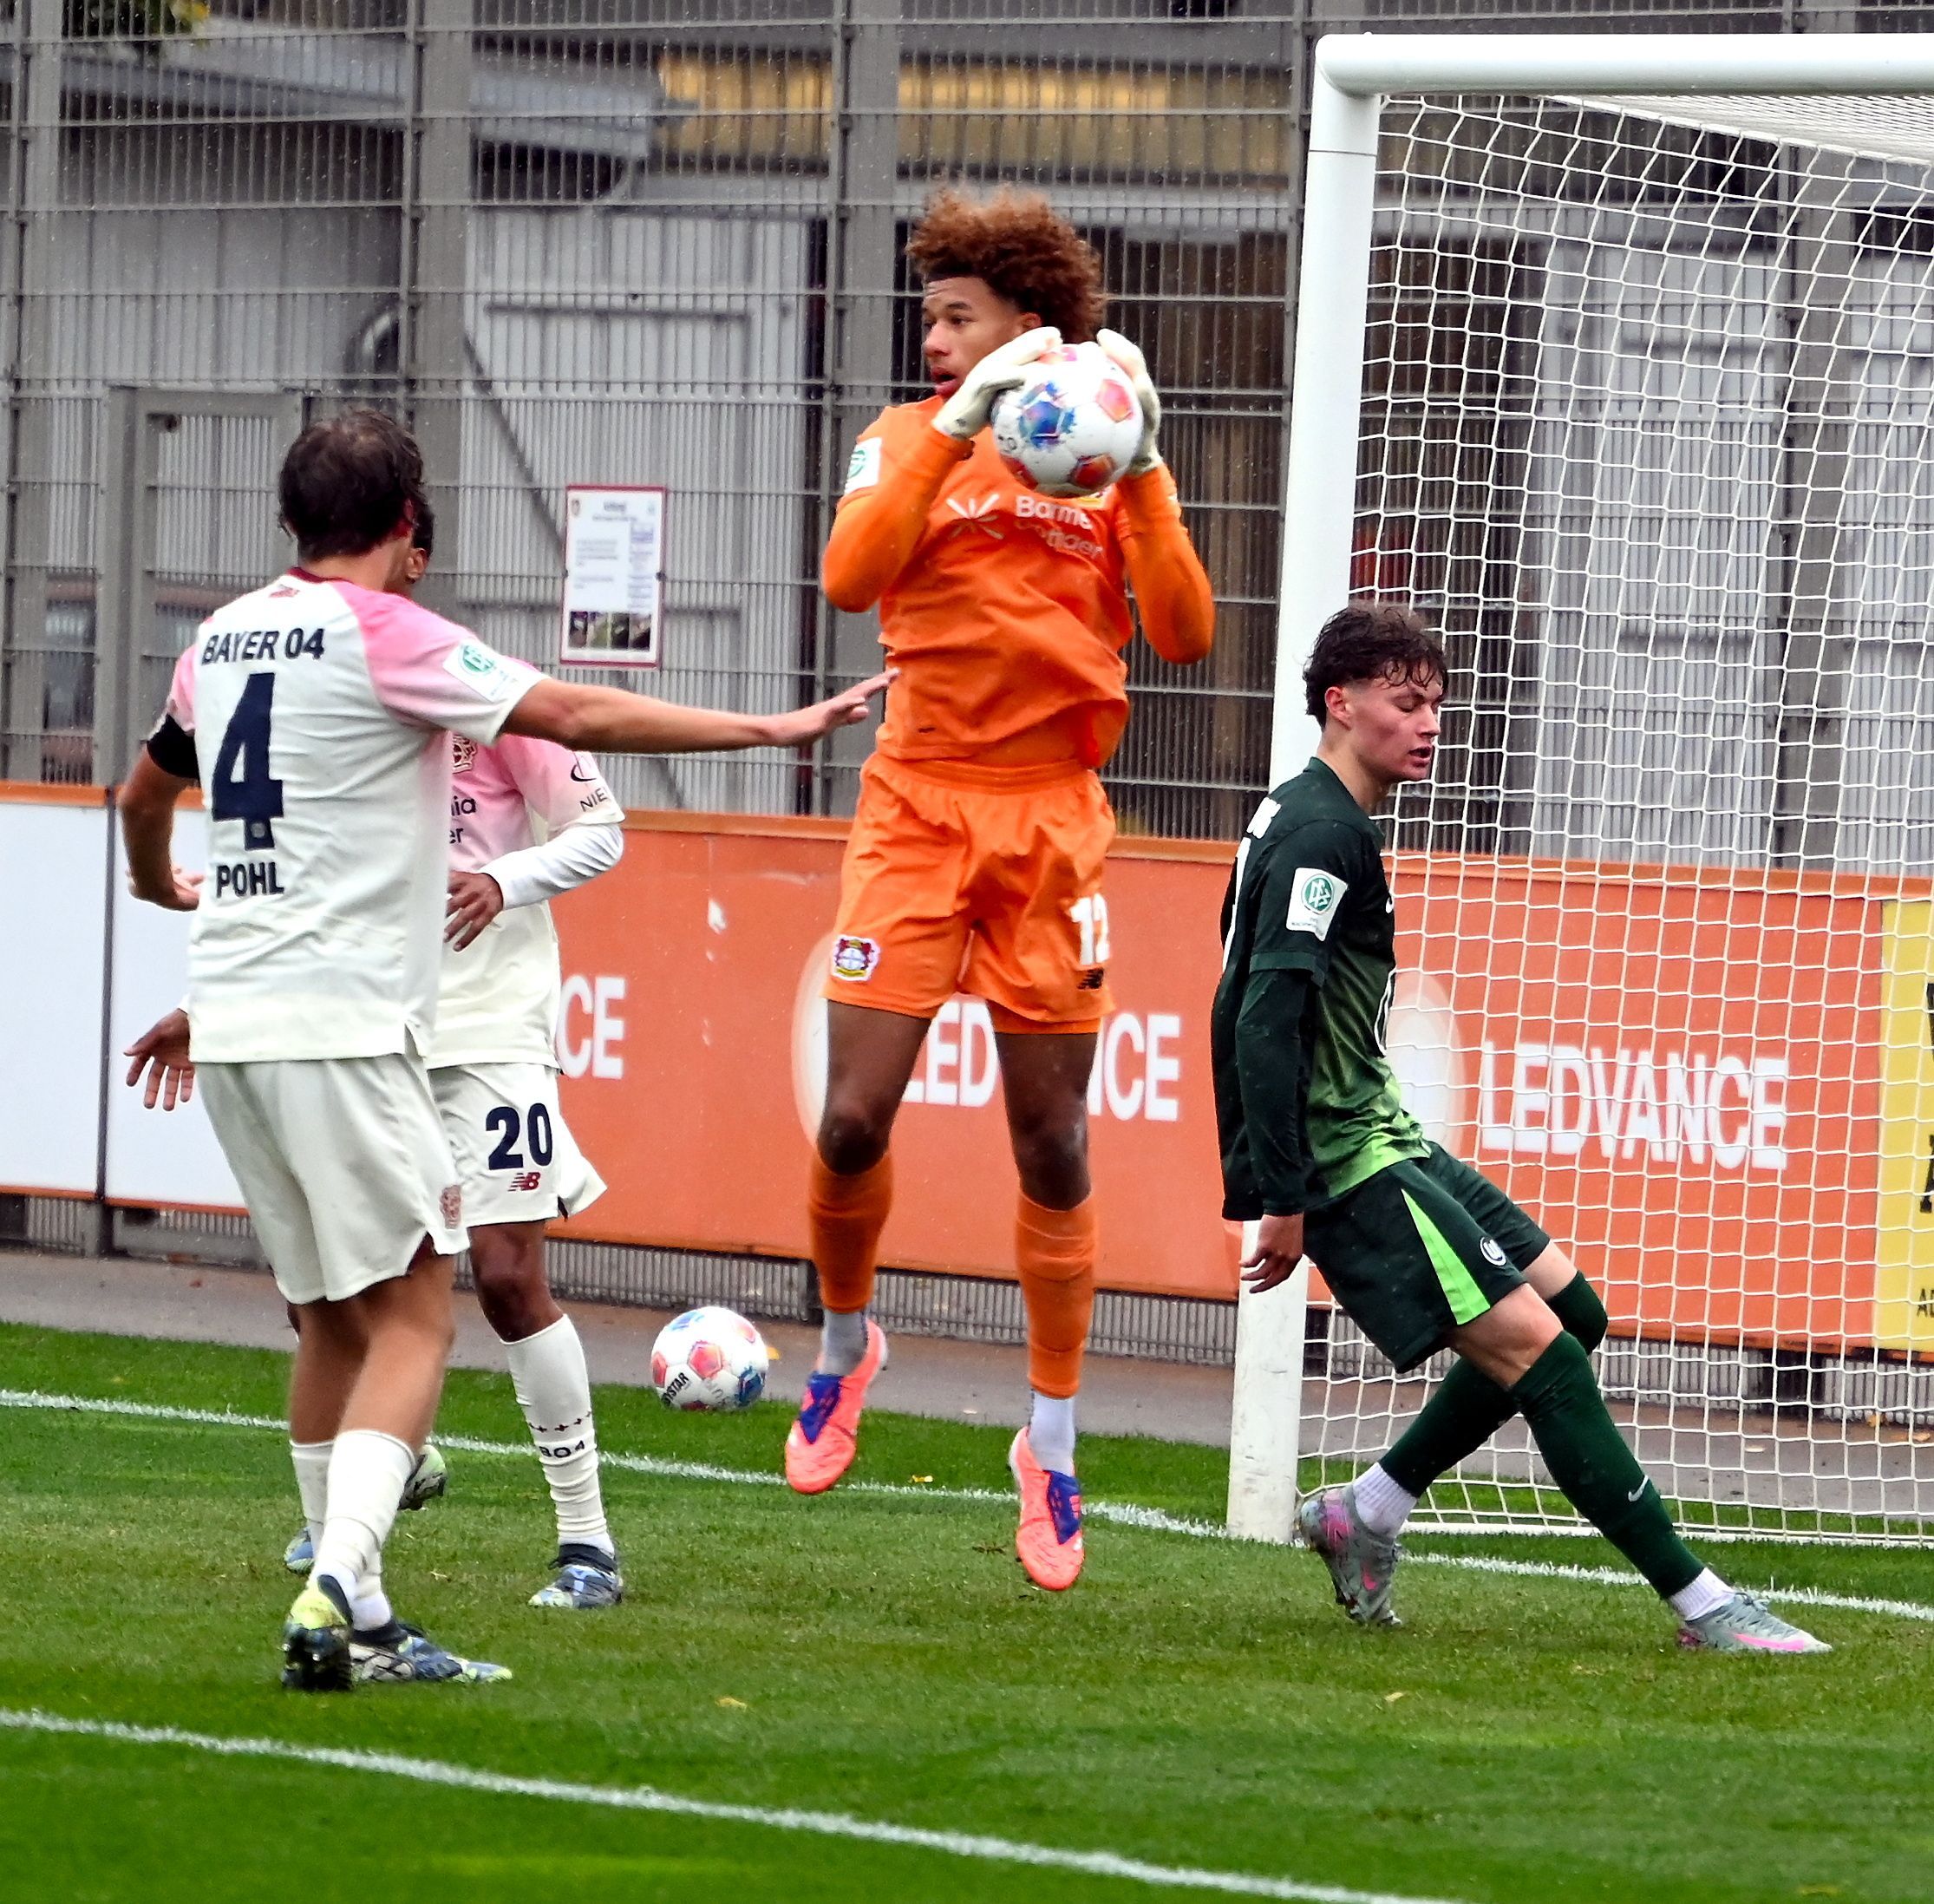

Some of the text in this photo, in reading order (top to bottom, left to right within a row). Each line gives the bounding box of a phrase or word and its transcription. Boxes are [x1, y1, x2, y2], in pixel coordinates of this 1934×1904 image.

[201, 627, 325, 665] BAYER 04
[212, 672, 284, 851] 4
[216, 861, 284, 899] POHL
[486, 1102, 553, 1170] 20
[1481, 1041, 1789, 1170] LEDVANCE
